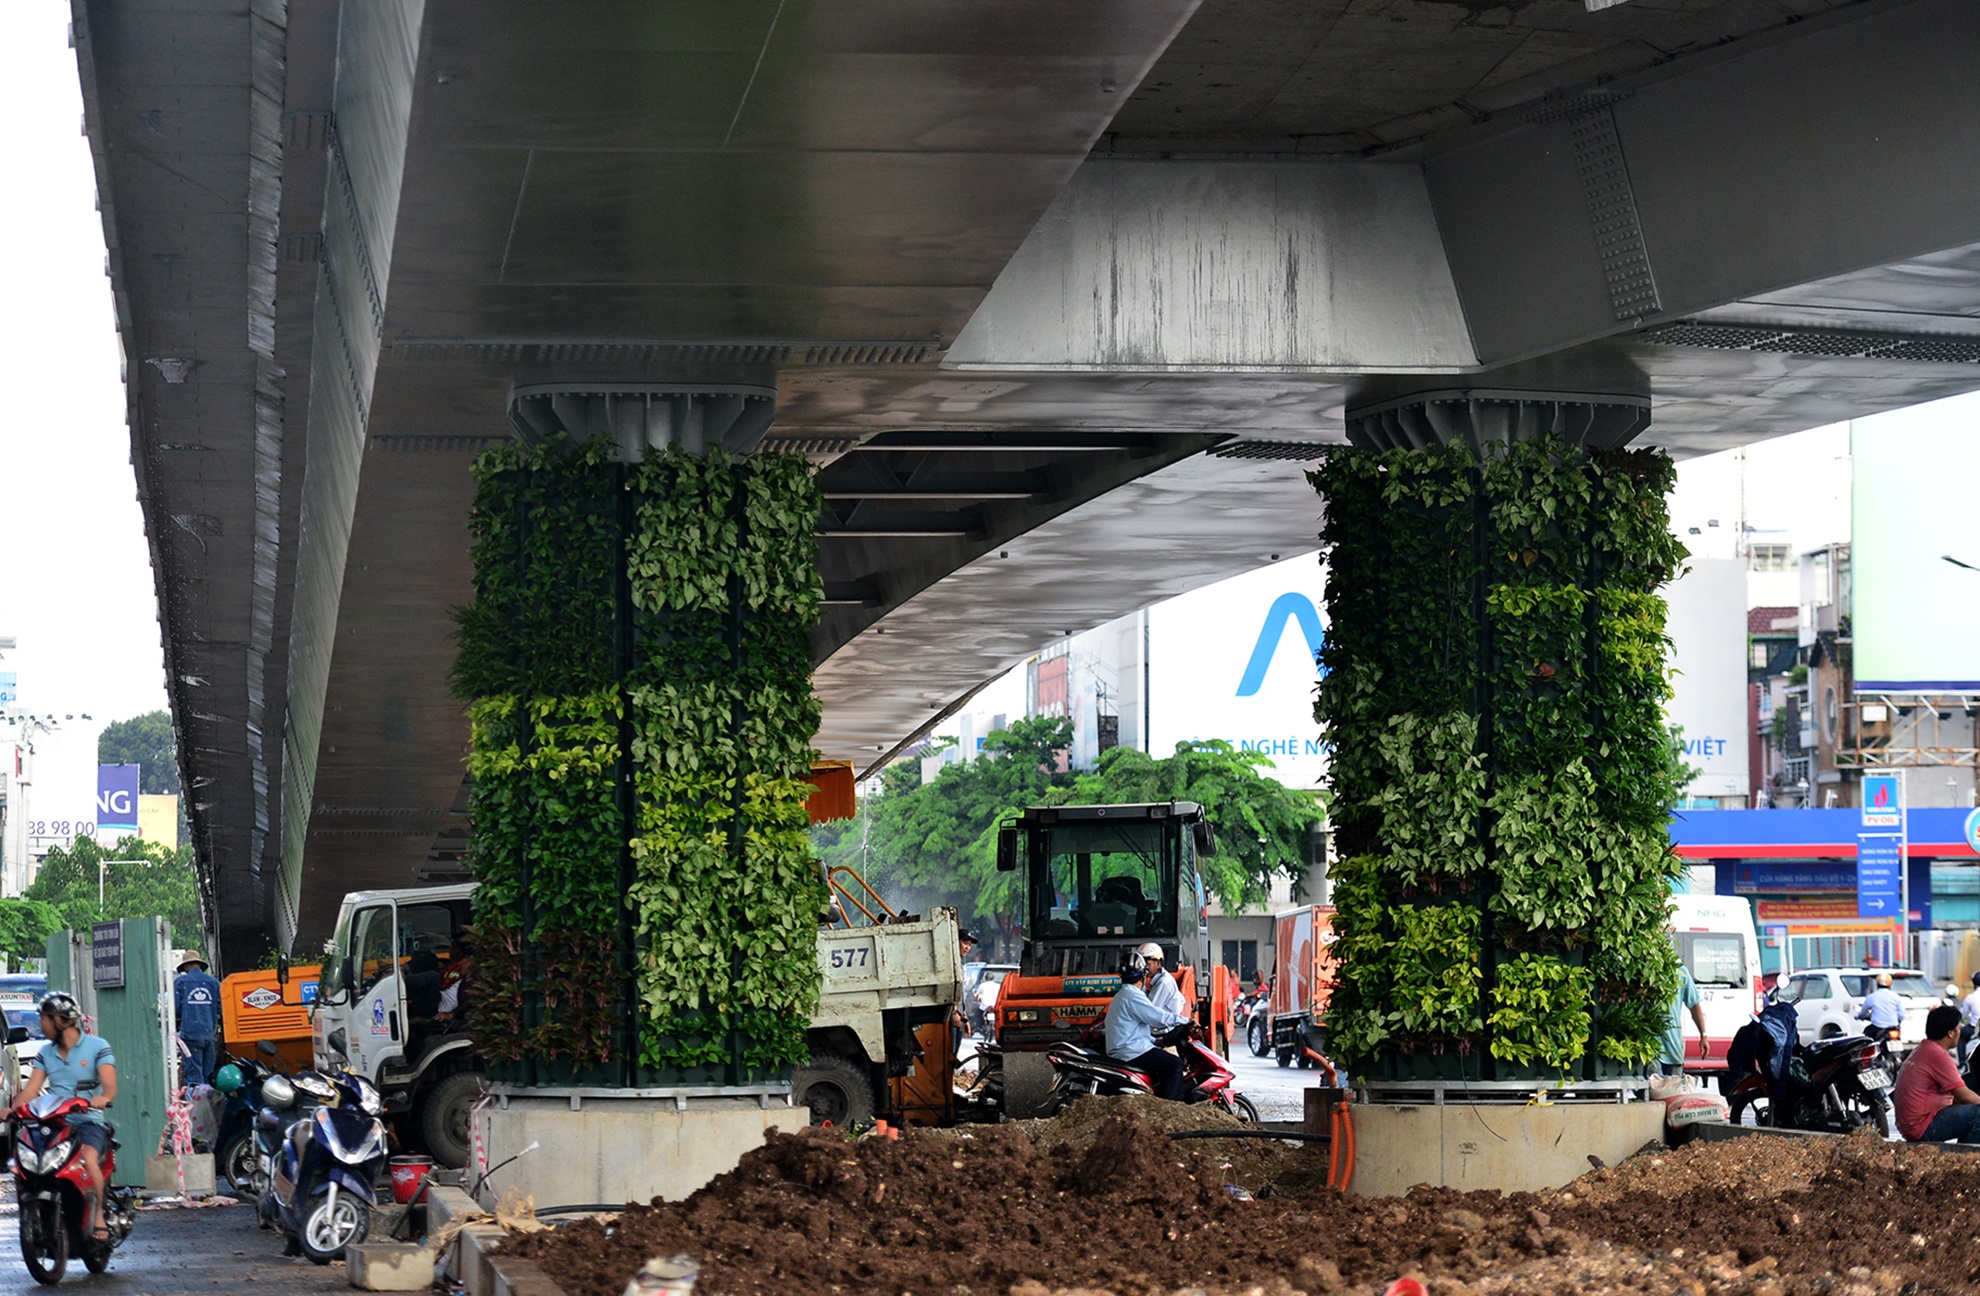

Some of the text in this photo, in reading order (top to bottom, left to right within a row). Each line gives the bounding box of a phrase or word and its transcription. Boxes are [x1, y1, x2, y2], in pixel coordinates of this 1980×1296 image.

[1241, 735, 1298, 760] NGHỆ
[1683, 736, 1727, 760] VIỆT
[51, 820, 70, 835] 98
[75, 820, 95, 836] 00
[1697, 909, 1726, 918] NHG
[831, 948, 869, 968] 577
[1060, 1007, 1097, 1016] HAMM
